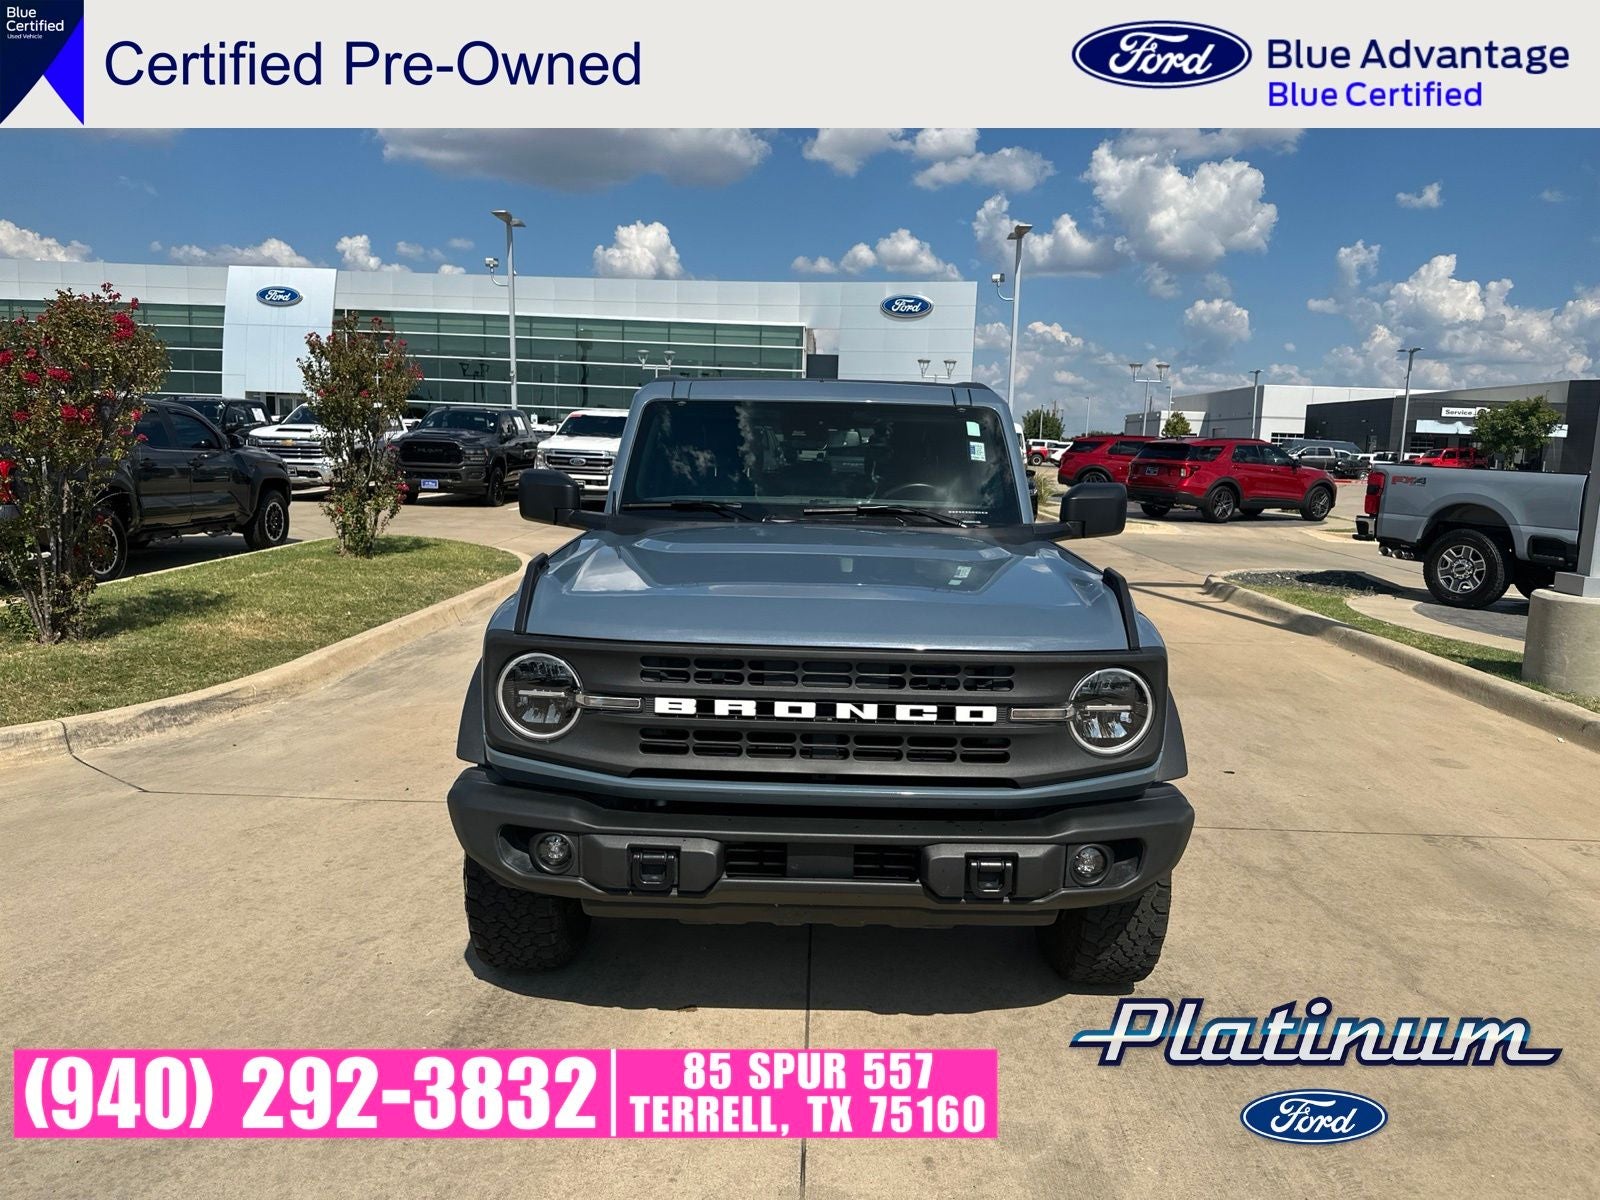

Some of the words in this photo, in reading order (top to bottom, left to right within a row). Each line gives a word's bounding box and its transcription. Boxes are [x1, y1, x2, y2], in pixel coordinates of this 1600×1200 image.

[265, 289, 291, 301] Ford
[891, 298, 922, 313] Ford
[653, 697, 998, 723] BRONCO
